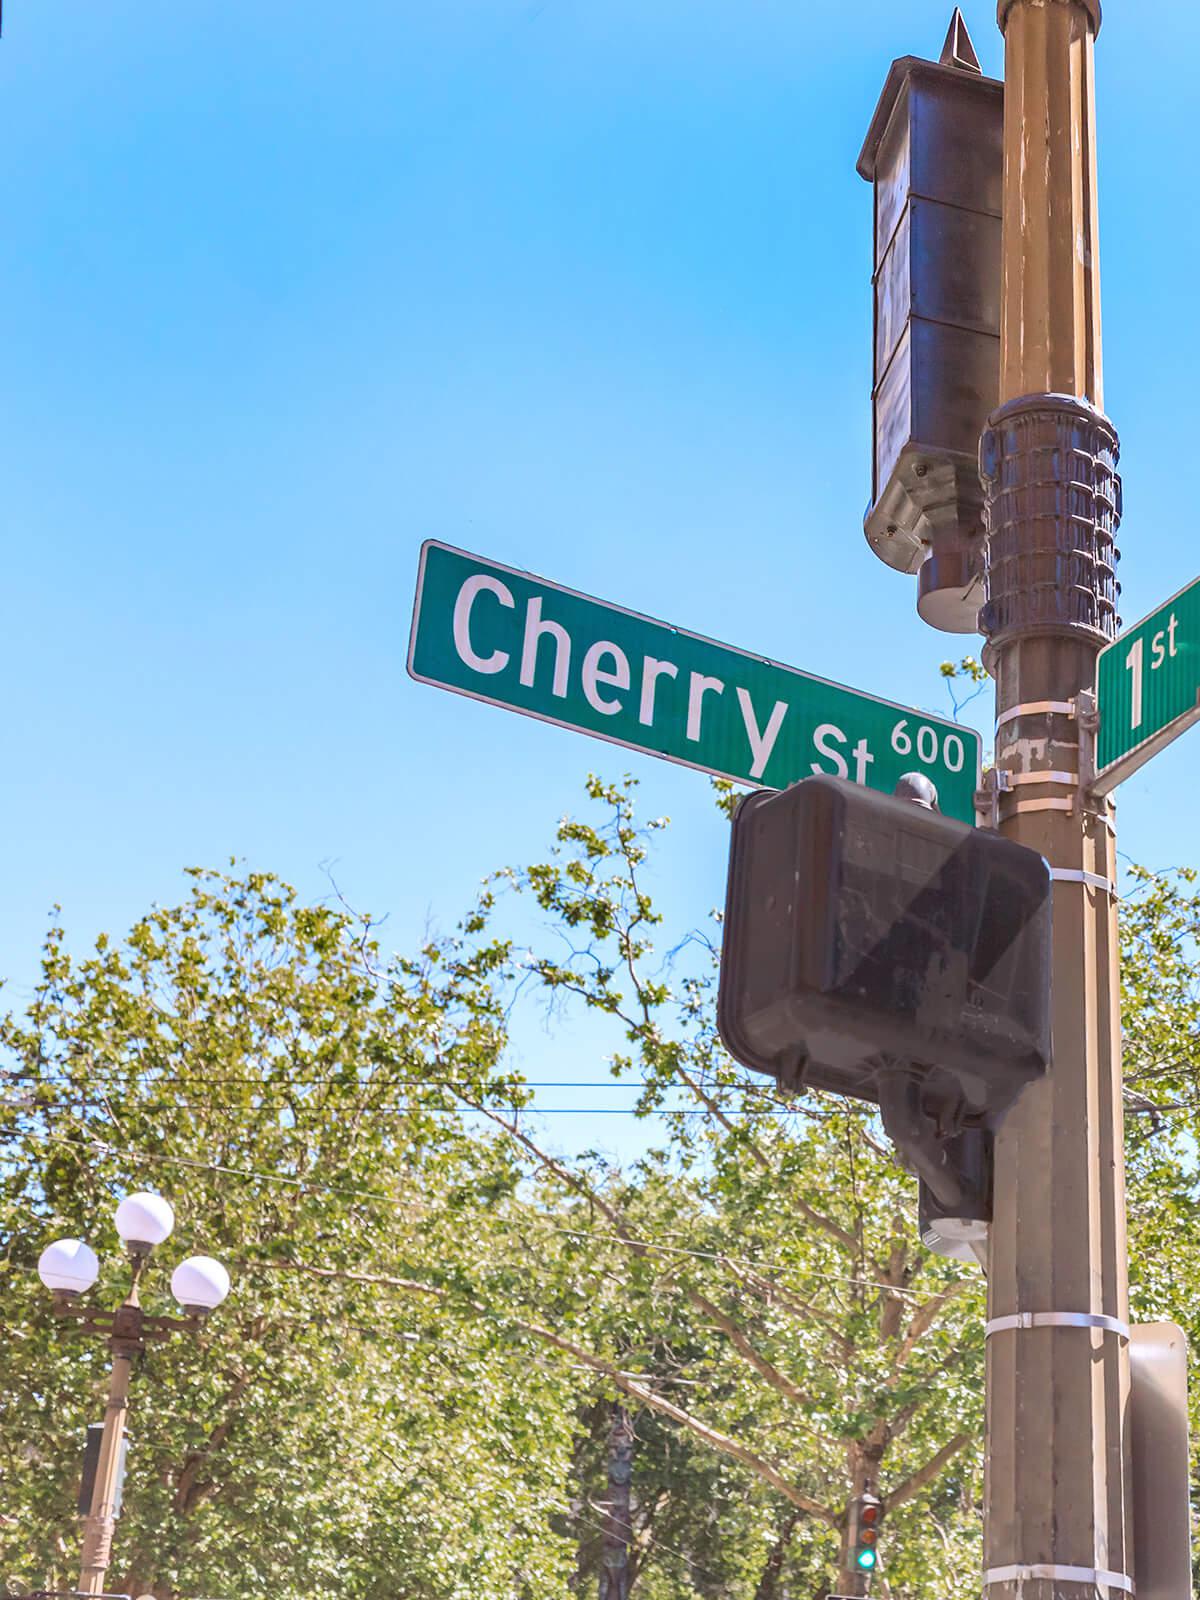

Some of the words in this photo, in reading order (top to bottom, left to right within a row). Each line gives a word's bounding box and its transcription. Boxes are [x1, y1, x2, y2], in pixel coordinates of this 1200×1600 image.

[453, 574, 789, 779] Cherry
[810, 723, 875, 786] St
[1125, 613, 1179, 730] 1st
[891, 719, 965, 773] 600
